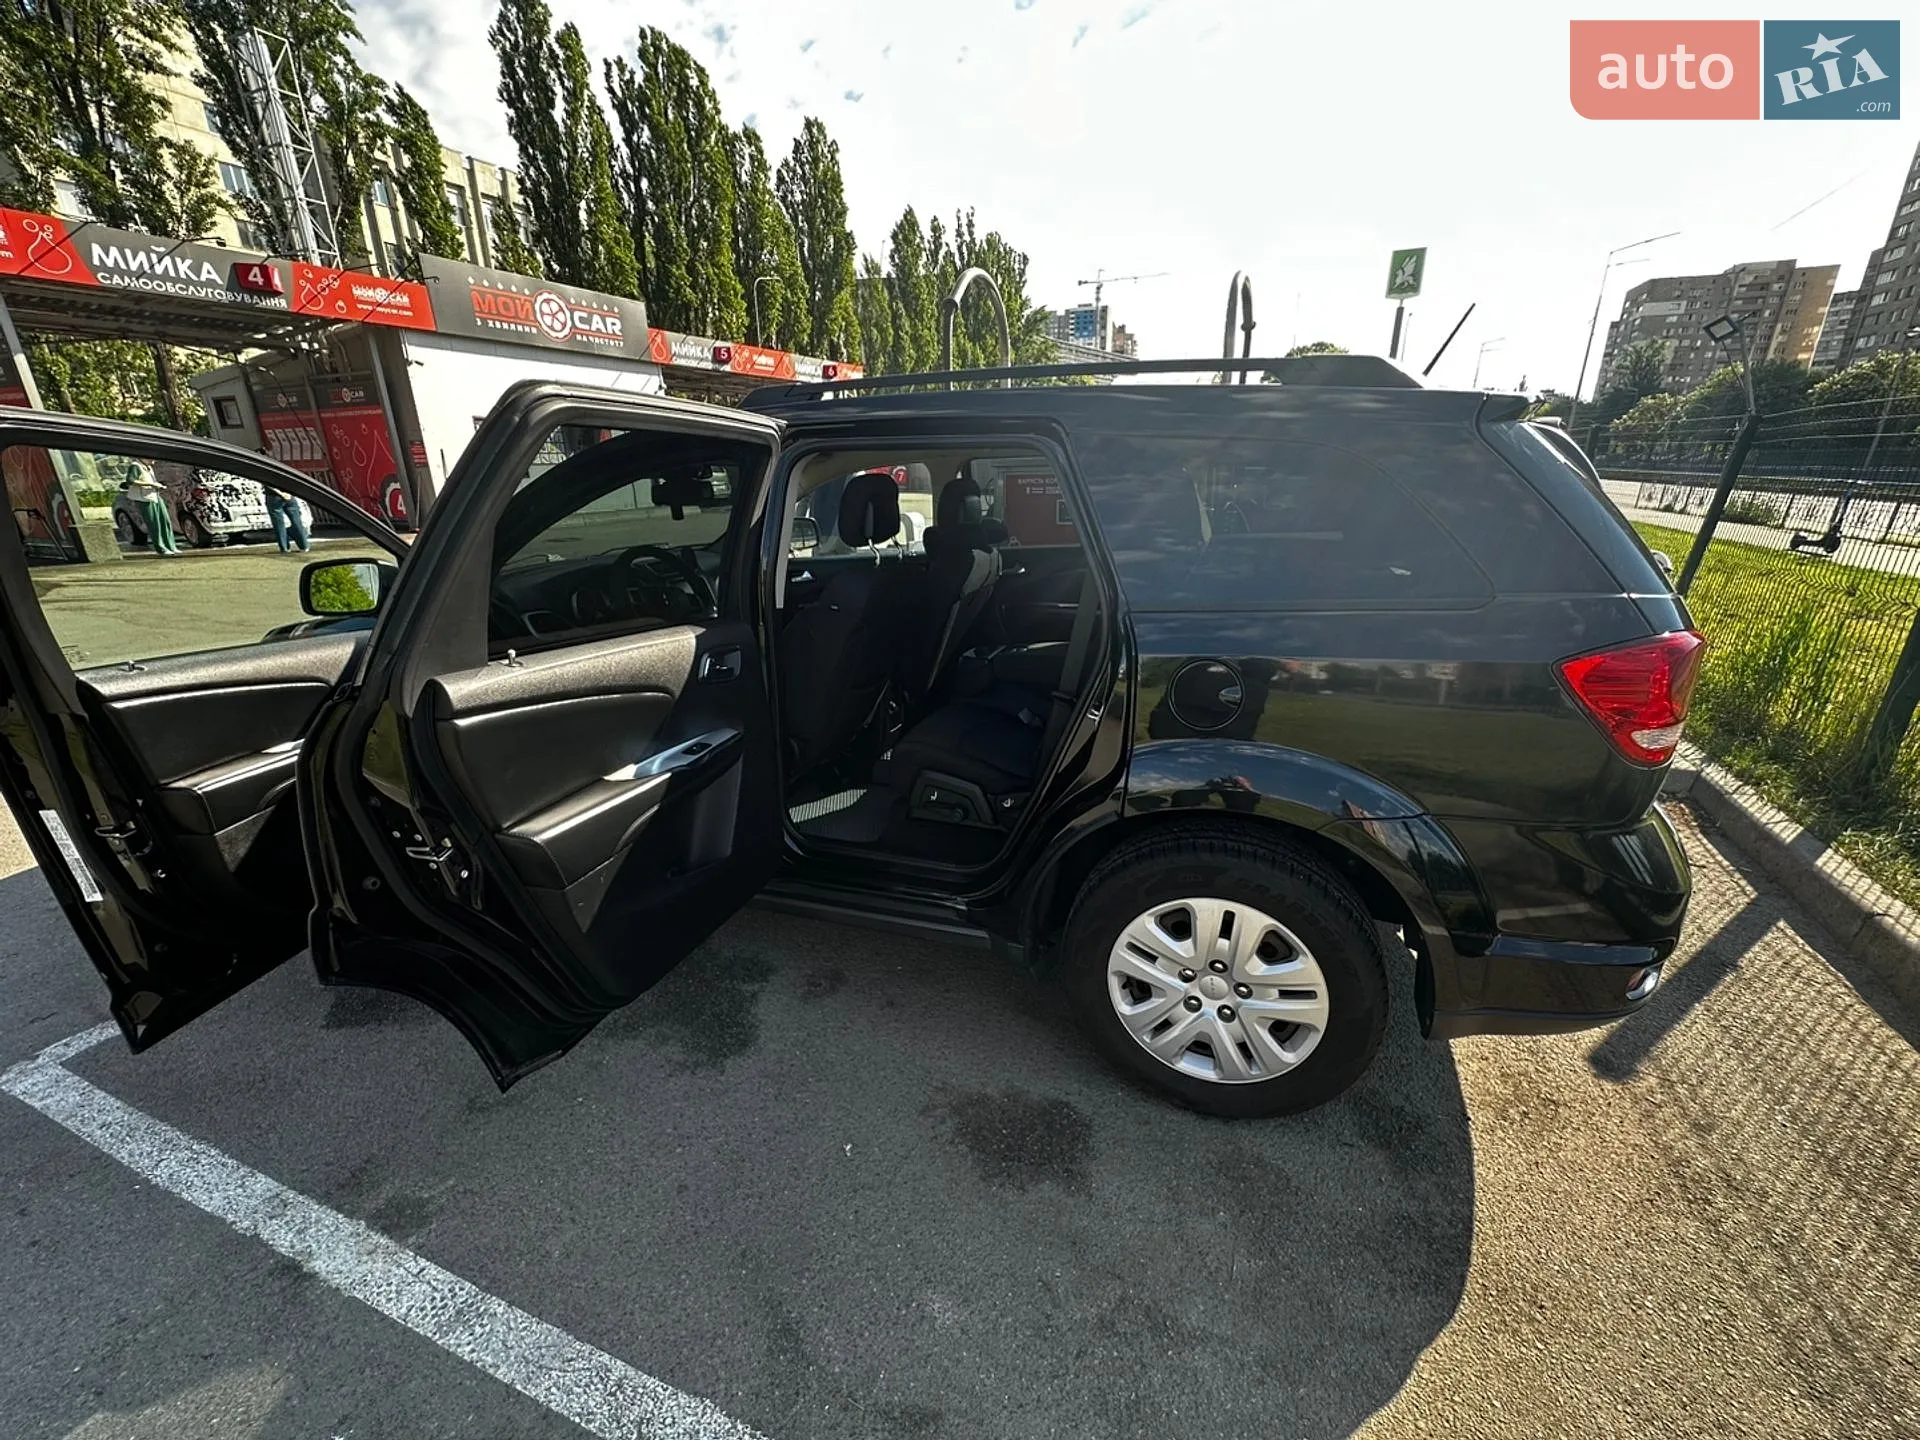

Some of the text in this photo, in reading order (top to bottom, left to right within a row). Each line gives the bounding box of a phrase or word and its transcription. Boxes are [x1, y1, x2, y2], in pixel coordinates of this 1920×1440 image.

[90, 242, 224, 285] МИЙКА
[248, 266, 264, 286] 4
[96, 272, 288, 309] САМООБСЛУГОВУВАННЯ
[471, 290, 623, 336] МОЙ CAR
[671, 341, 712, 360] МИЙКА
[720, 348, 728, 359] 5
[828, 366, 835, 376] 6
[397, 494, 407, 515] 4
